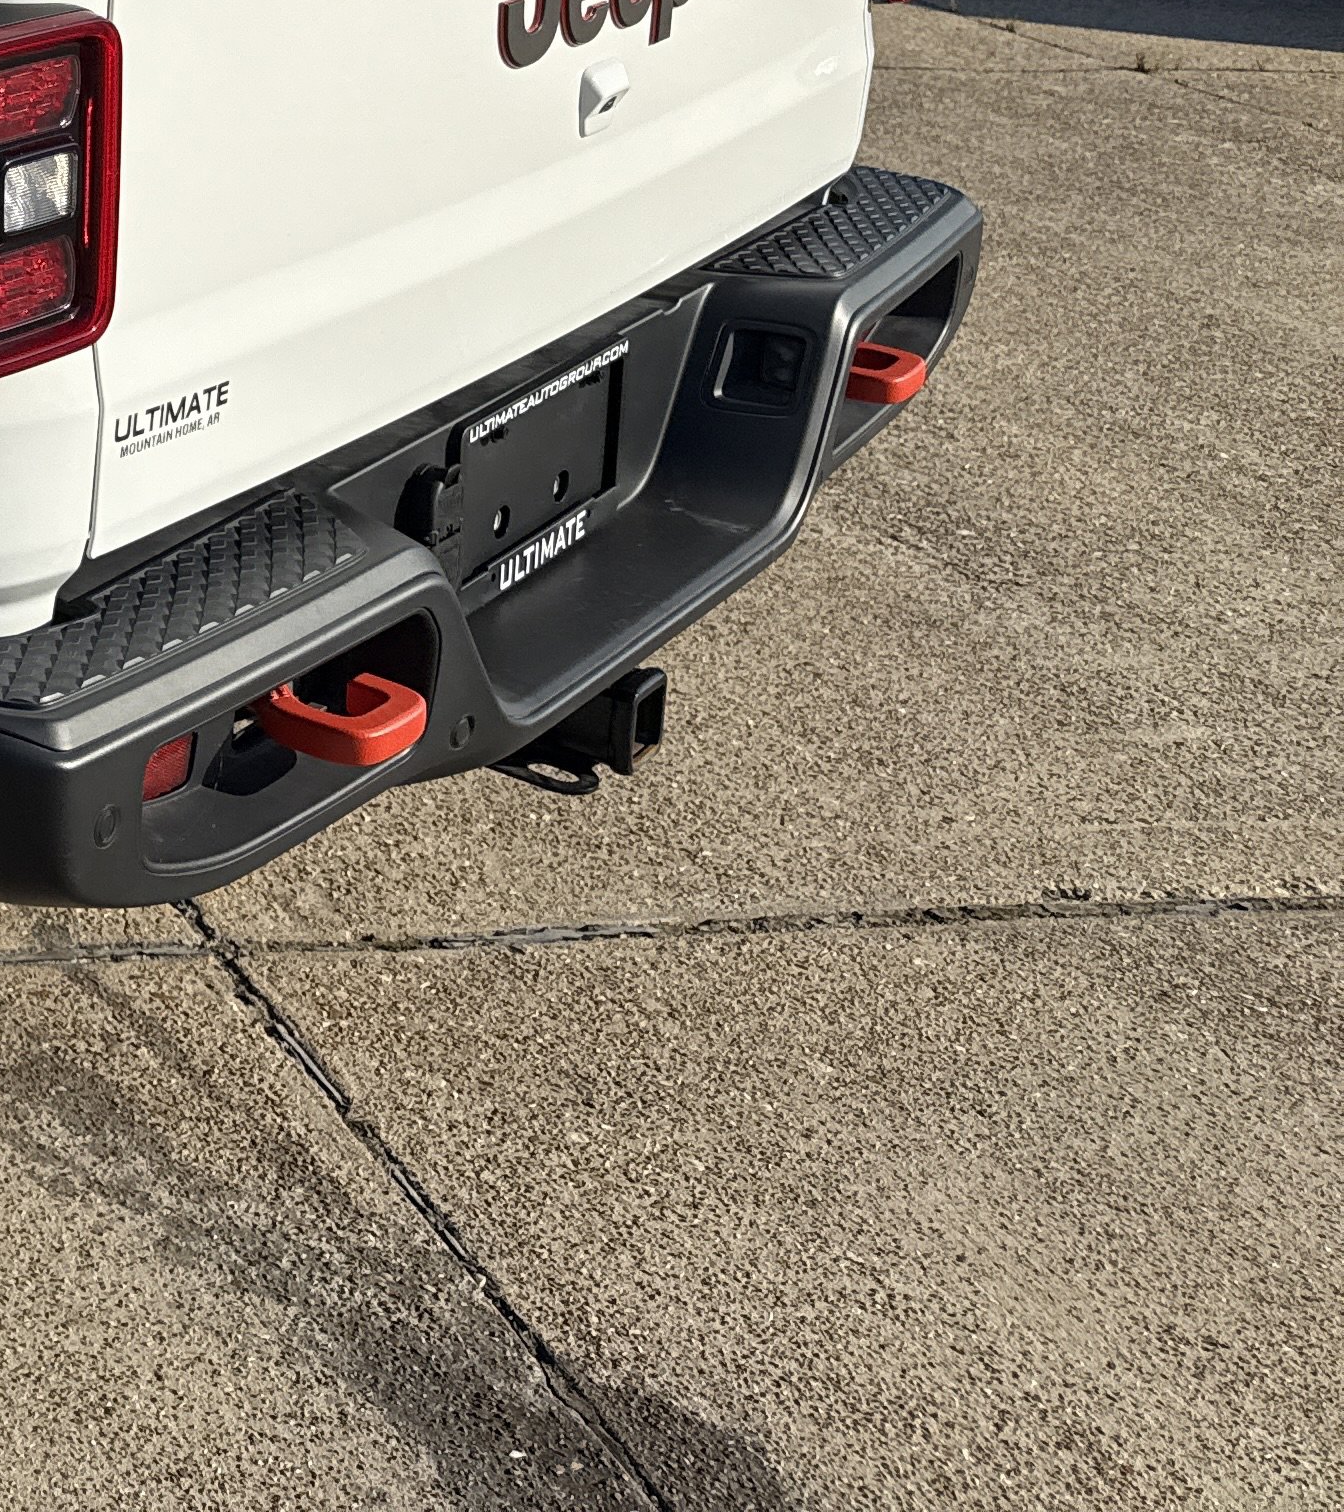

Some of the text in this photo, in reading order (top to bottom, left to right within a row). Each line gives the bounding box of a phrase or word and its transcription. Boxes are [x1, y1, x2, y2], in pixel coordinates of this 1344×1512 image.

[114, 380, 230, 443] ULTIMATE
[119, 428, 173, 459] MOUNTAIN
[207, 411, 220, 428] AR
[500, 509, 587, 591] ULTIMATE
